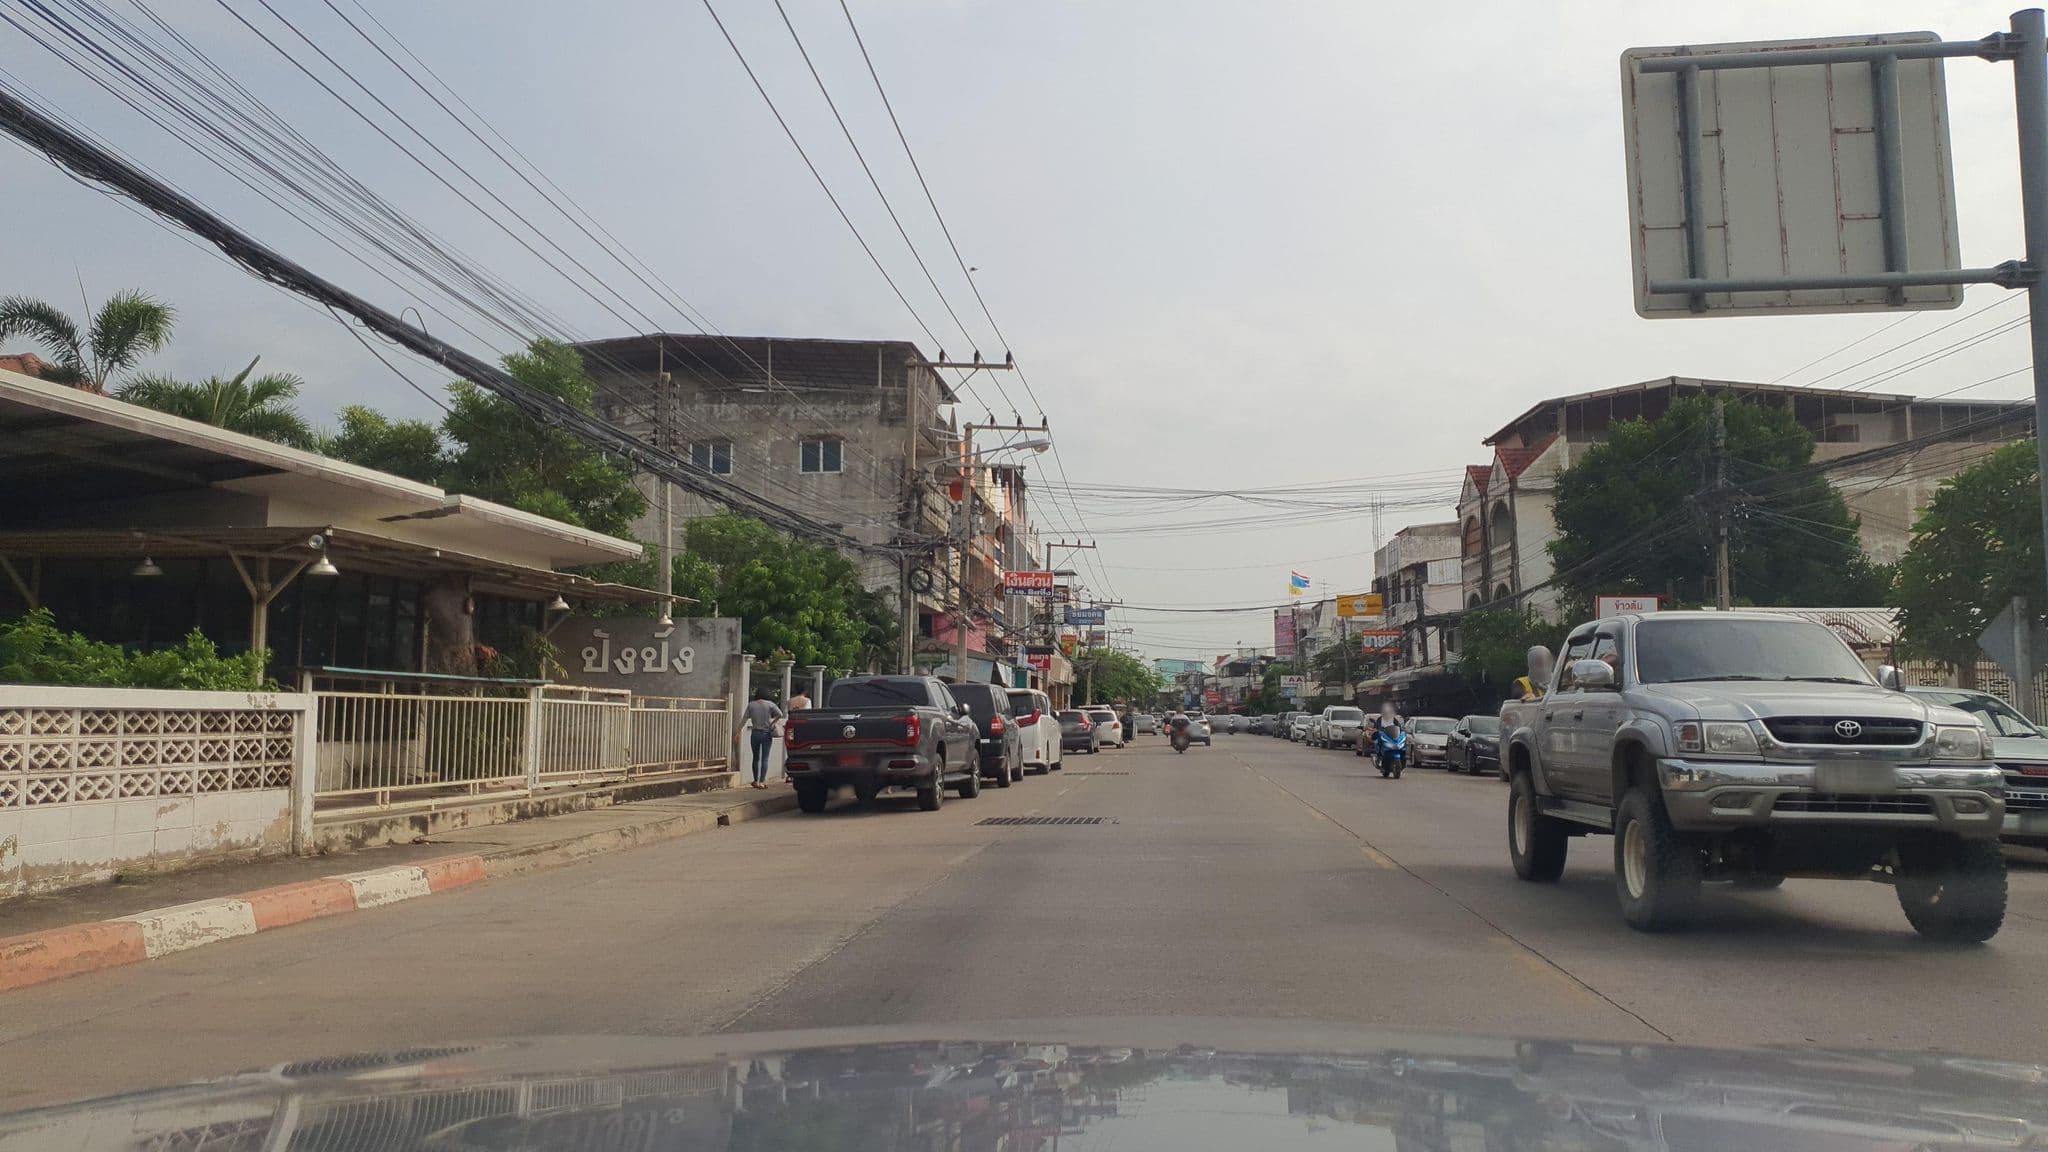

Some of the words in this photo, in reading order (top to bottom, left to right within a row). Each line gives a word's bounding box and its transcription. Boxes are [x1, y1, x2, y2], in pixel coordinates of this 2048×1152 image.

[1006, 573, 1051, 587] เงินด่วน
[1615, 600, 1643, 610] ข้าวต้ม
